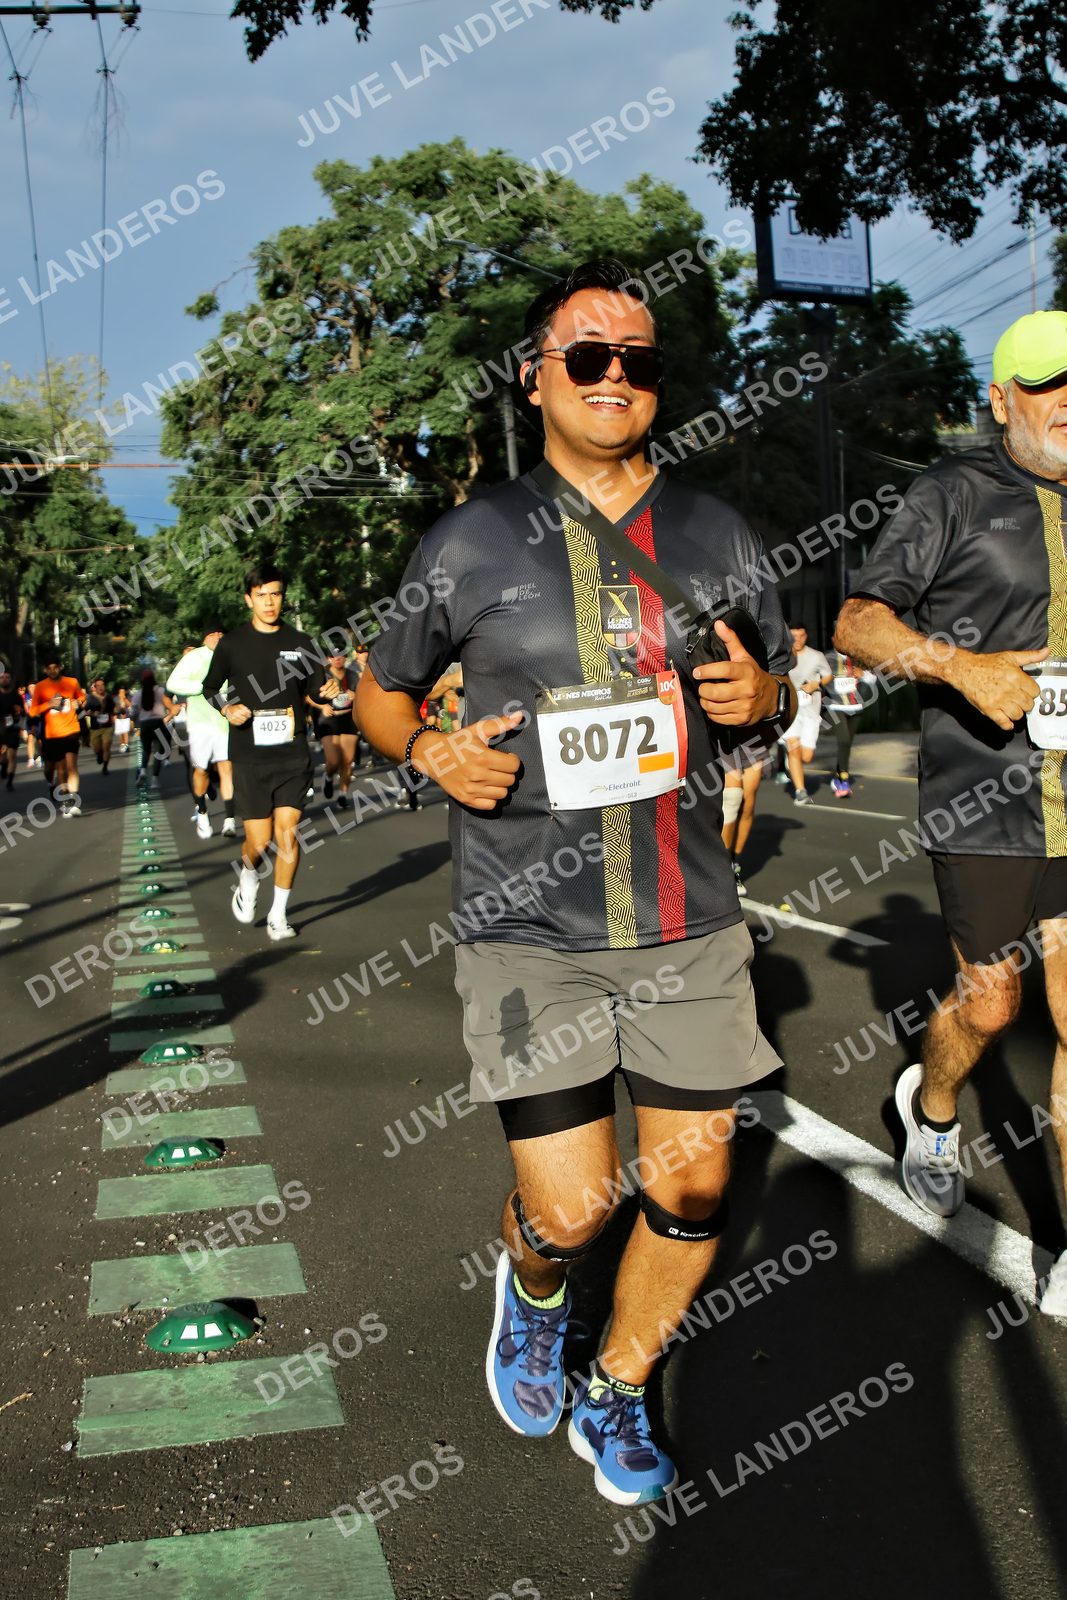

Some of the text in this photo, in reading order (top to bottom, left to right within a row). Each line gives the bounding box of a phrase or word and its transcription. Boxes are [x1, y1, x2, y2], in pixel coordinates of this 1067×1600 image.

[519, 582, 536, 590] PIEL
[581, 687, 612, 697] NEGROS
[260, 720, 287, 732] 4025
[558, 715, 658, 766] 8072
[608, 780, 641, 791] Electrolit
